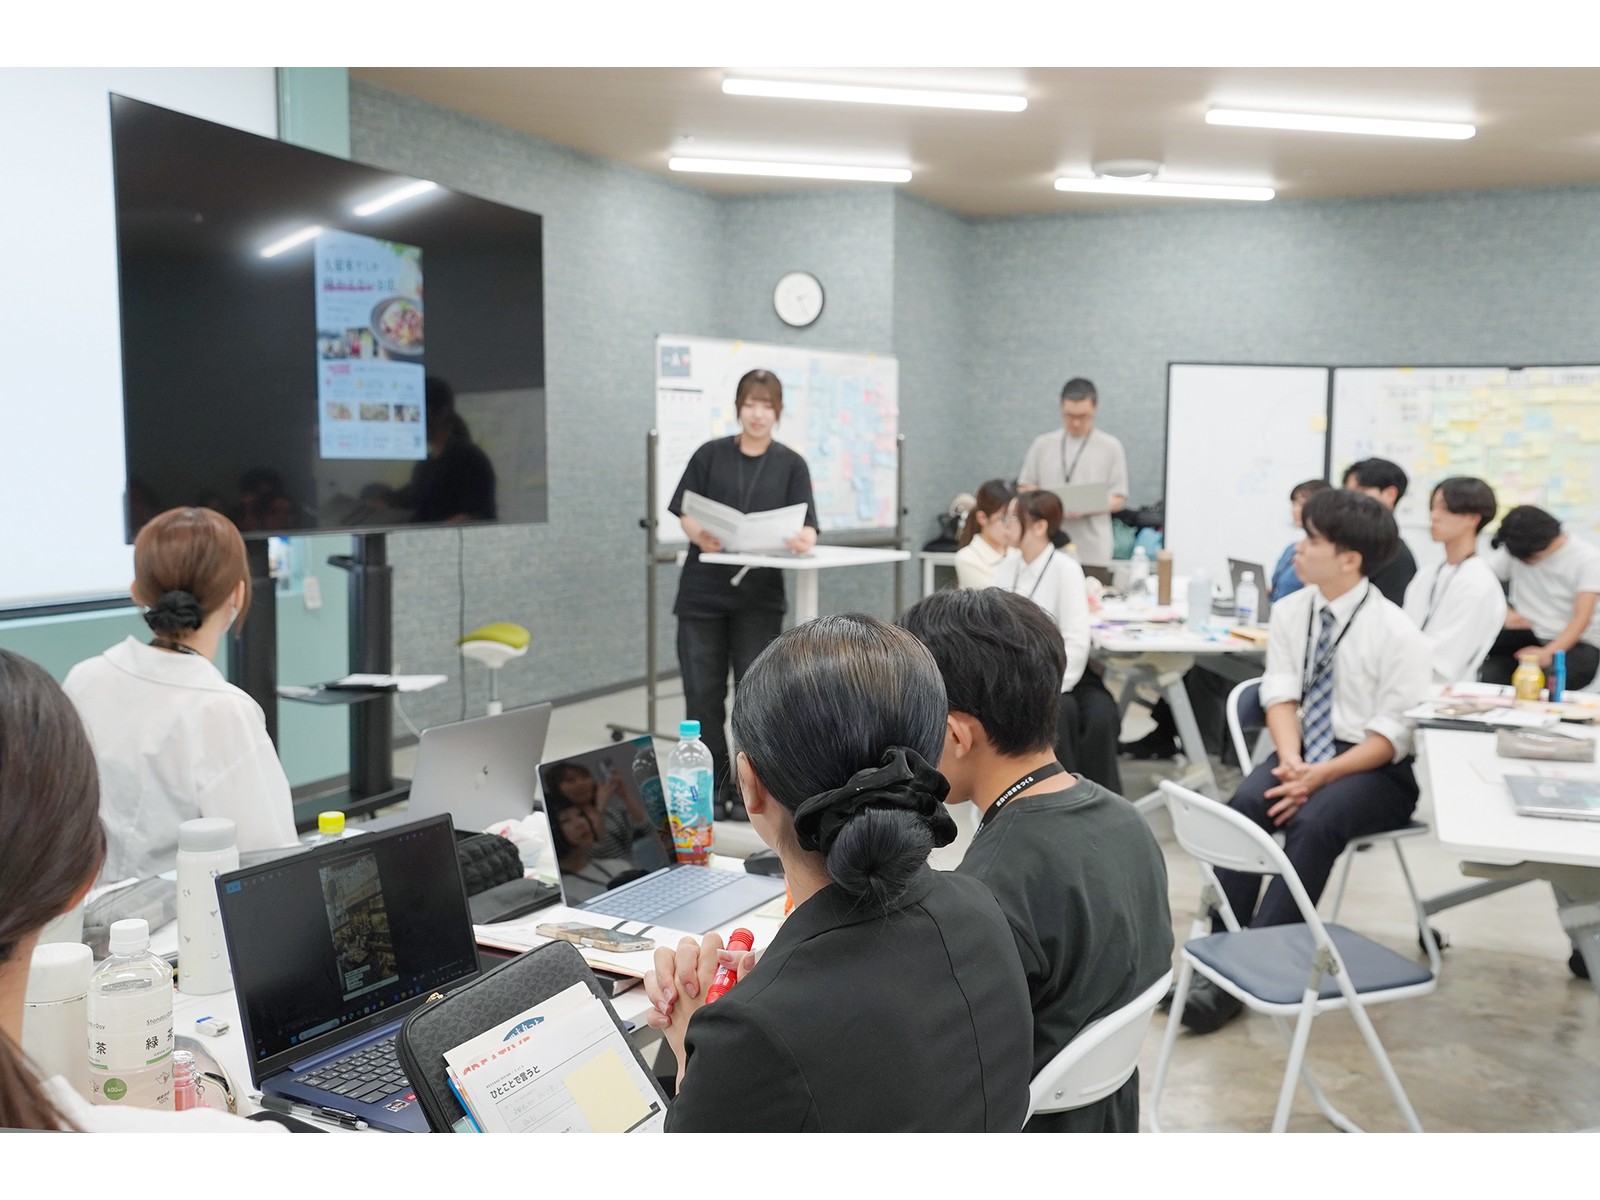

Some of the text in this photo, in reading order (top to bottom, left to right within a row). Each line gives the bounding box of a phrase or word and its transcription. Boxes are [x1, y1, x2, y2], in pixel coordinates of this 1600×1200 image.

[490, 1065, 541, 1099] ひとことで言うと
